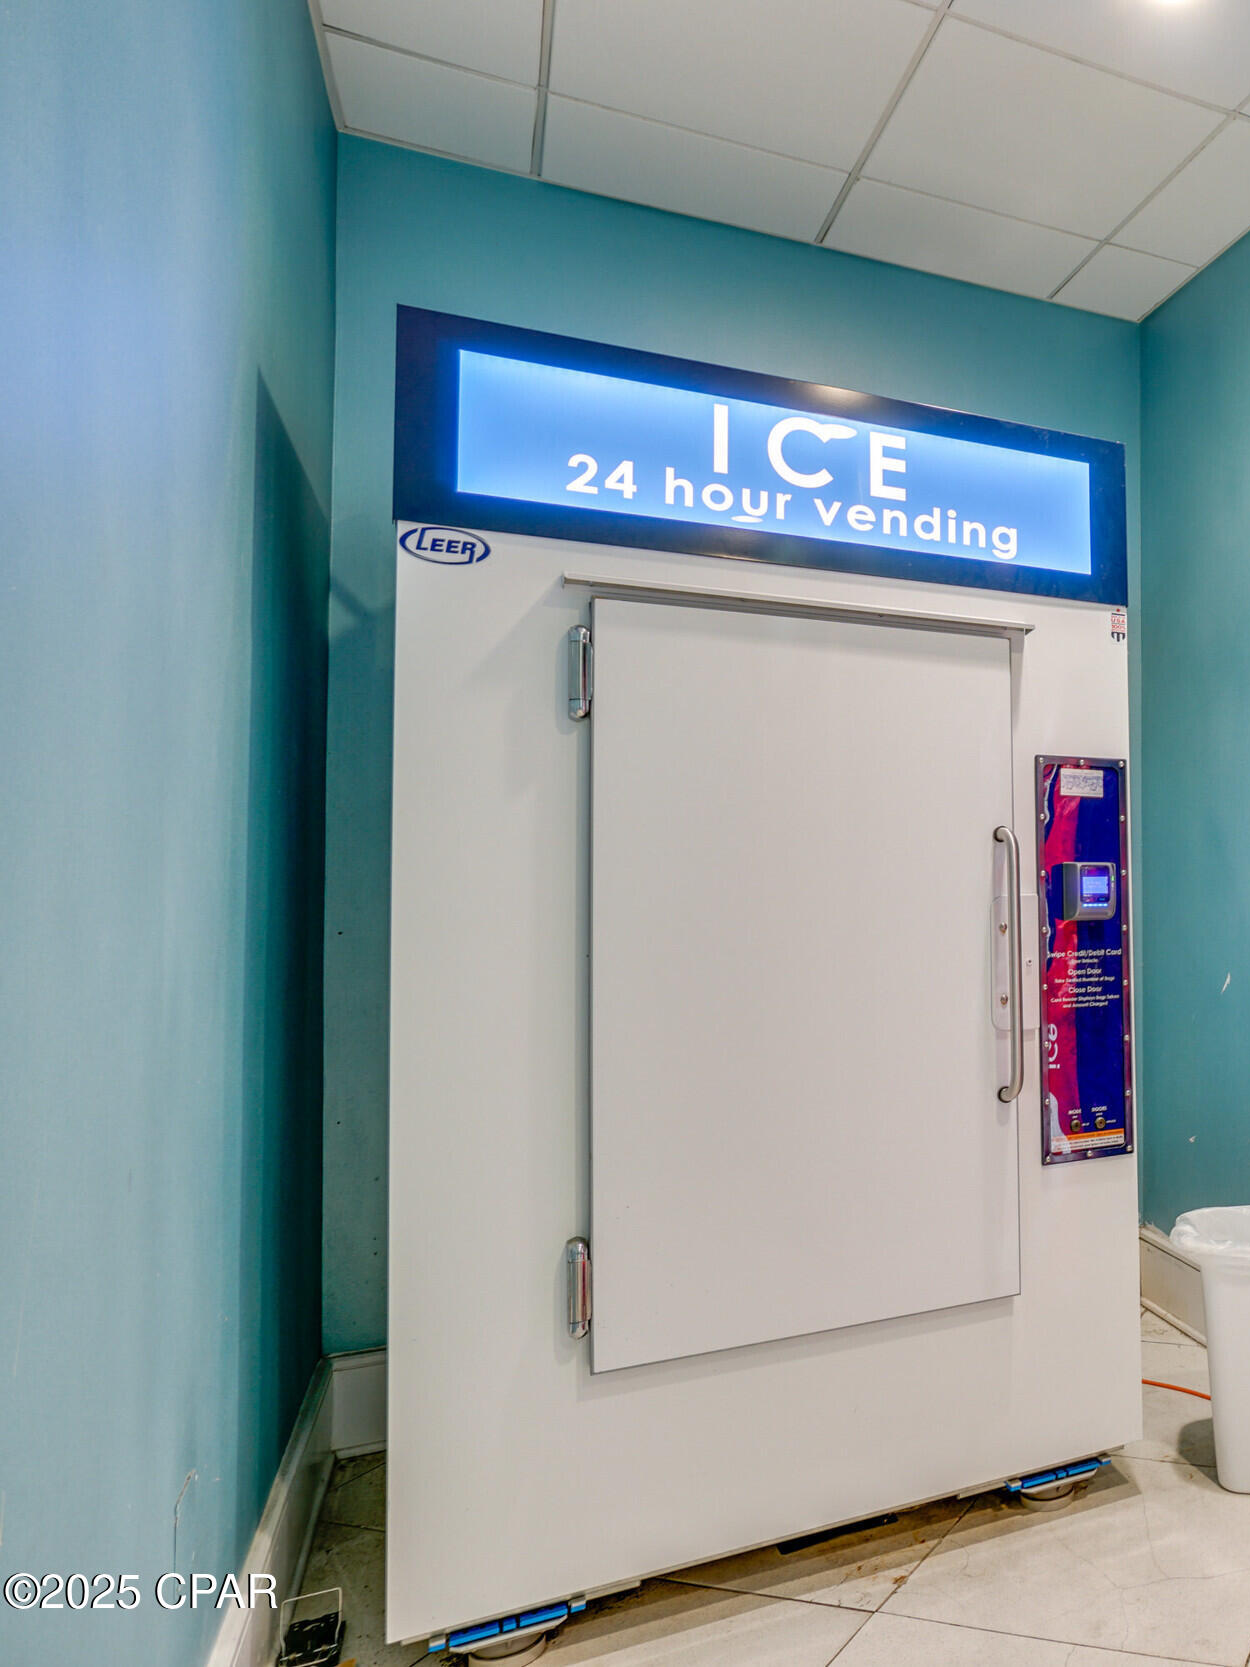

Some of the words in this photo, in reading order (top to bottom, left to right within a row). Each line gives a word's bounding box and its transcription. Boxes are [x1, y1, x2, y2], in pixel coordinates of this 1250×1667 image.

[714, 403, 906, 502] ICE
[566, 453, 638, 500] 24
[664, 466, 792, 521] hour
[814, 498, 1019, 561] vending
[416, 527, 477, 565] LEER
[1067, 968, 1086, 977] Open
[1087, 967, 1102, 975] Door
[1068, 986, 1086, 994] Close
[1087, 985, 1102, 993] Door
